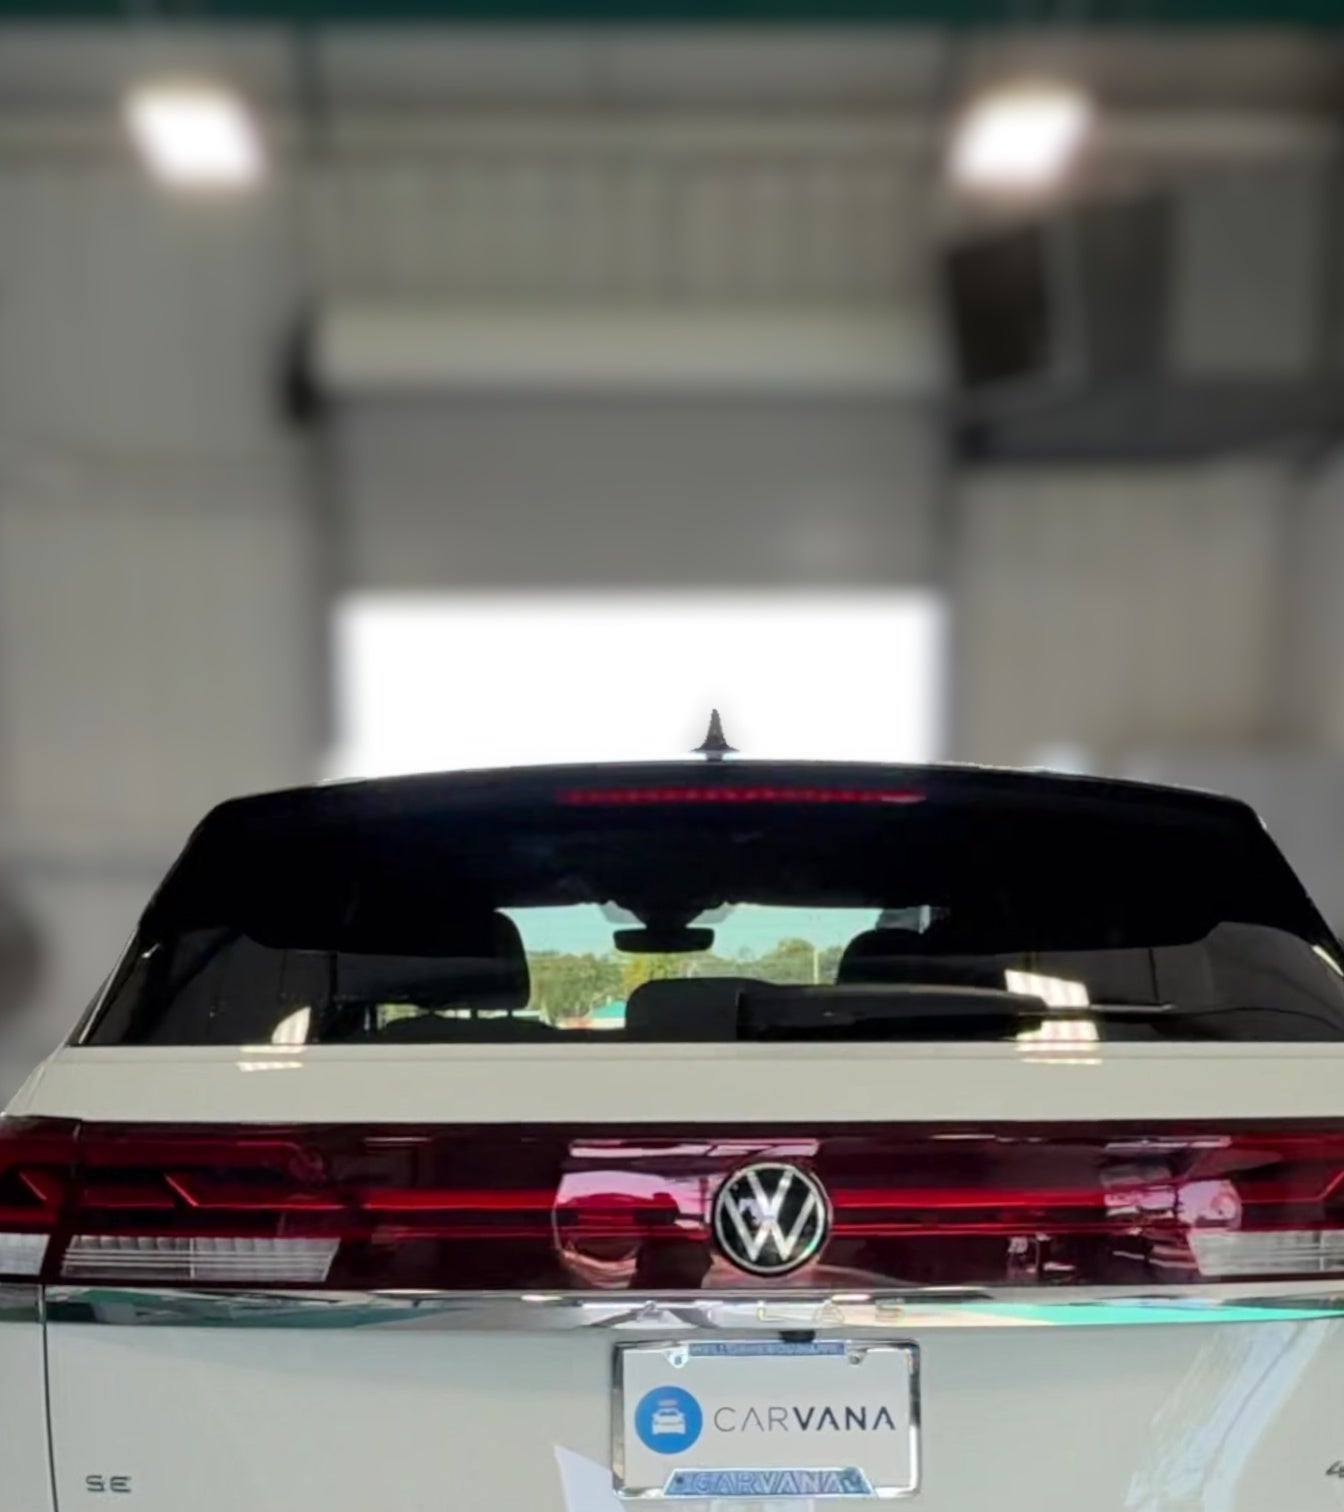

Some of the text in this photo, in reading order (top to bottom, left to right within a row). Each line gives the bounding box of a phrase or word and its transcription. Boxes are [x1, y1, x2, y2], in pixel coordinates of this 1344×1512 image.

[719, 1165, 825, 1265] VW
[713, 1405, 896, 1433] CARVANA
[85, 1474, 132, 1493] SE
[694, 1470, 846, 1495] CARVANA
